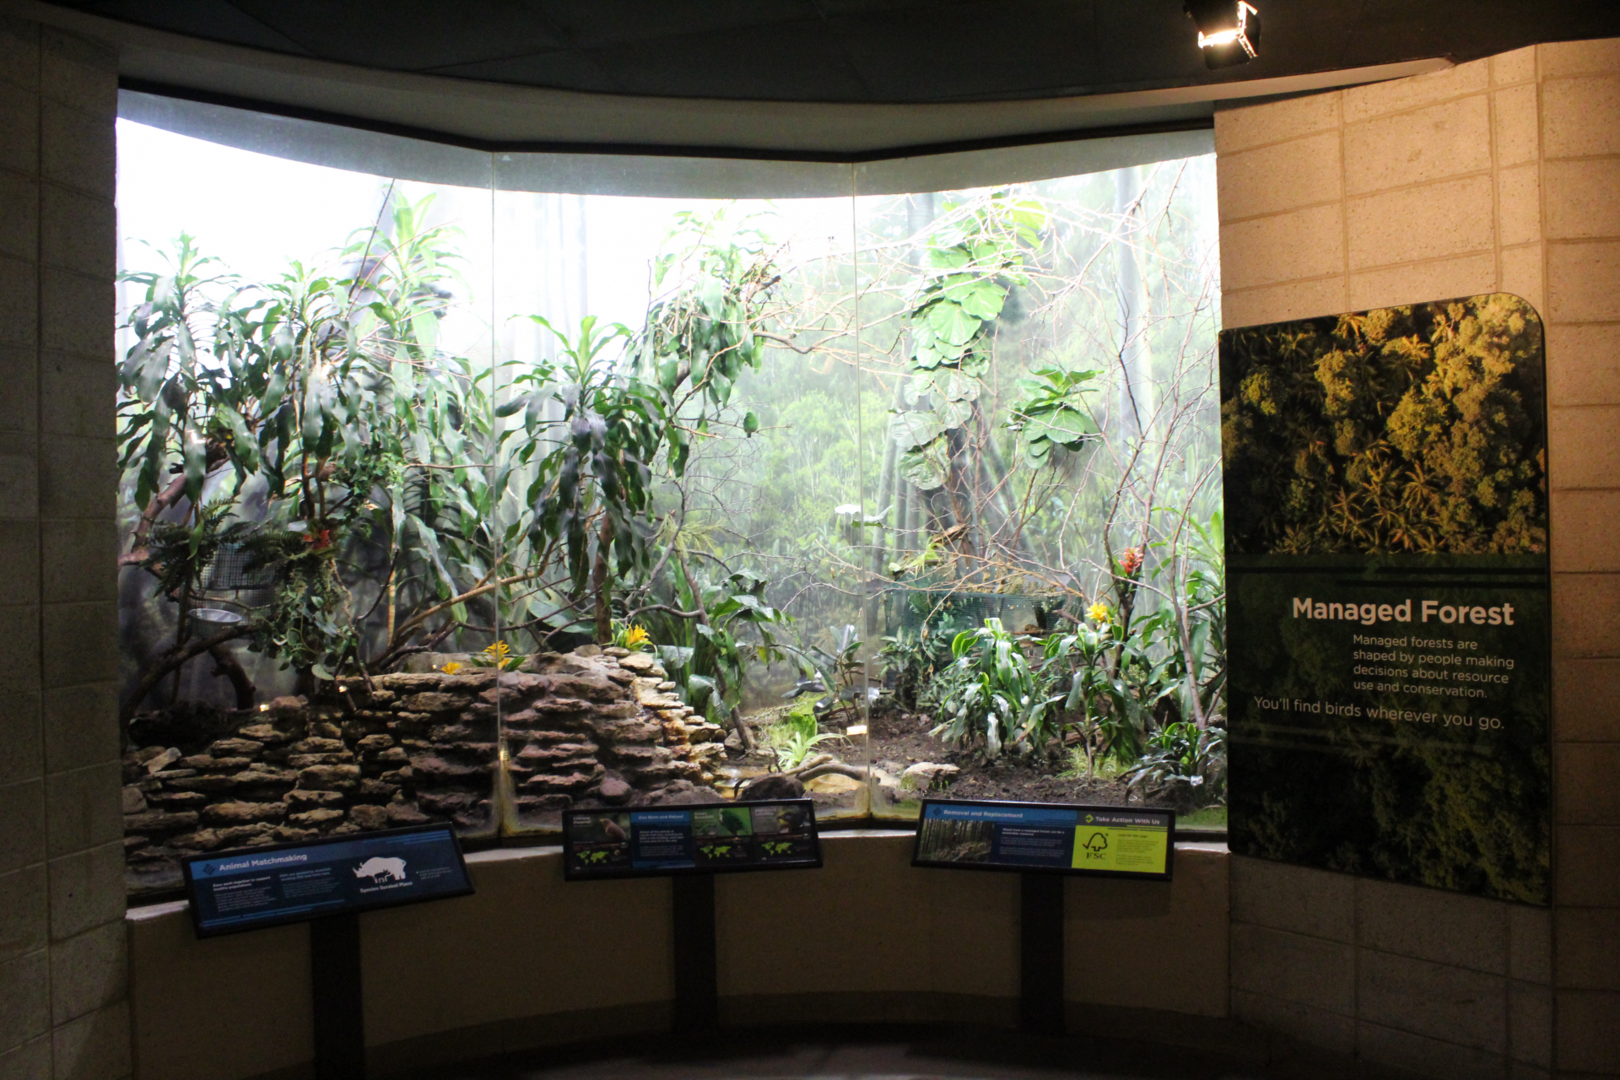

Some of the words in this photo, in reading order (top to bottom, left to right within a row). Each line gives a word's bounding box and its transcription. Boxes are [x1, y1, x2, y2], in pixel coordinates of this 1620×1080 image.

[1293, 598, 1411, 625] Managed
[1422, 600, 1514, 625] Forest
[1354, 634, 1407, 647] Managed
[1411, 636, 1453, 648] forests
[1457, 641, 1477, 650] are
[1354, 650, 1396, 662] shaped
[1400, 652, 1414, 664] by
[1419, 654, 1462, 666] people
[1466, 656, 1514, 669] making
[1354, 664, 1408, 677] decisions
[1412, 668, 1448, 679] about
[1453, 672, 1508, 683] resource
[1354, 682, 1373, 690] use
[1377, 682, 1399, 692] and
[1403, 685, 1487, 697] conservation.
[1254, 696, 1289, 710] You'll
[1294, 699, 1320, 713] find
[1325, 702, 1361, 717] birds
[1367, 705, 1437, 722] wherever
[1443, 714, 1472, 727] you
[1479, 717, 1504, 730] go.
[219, 861, 249, 871] Animal
[251, 854, 307, 867] Matchmaking
